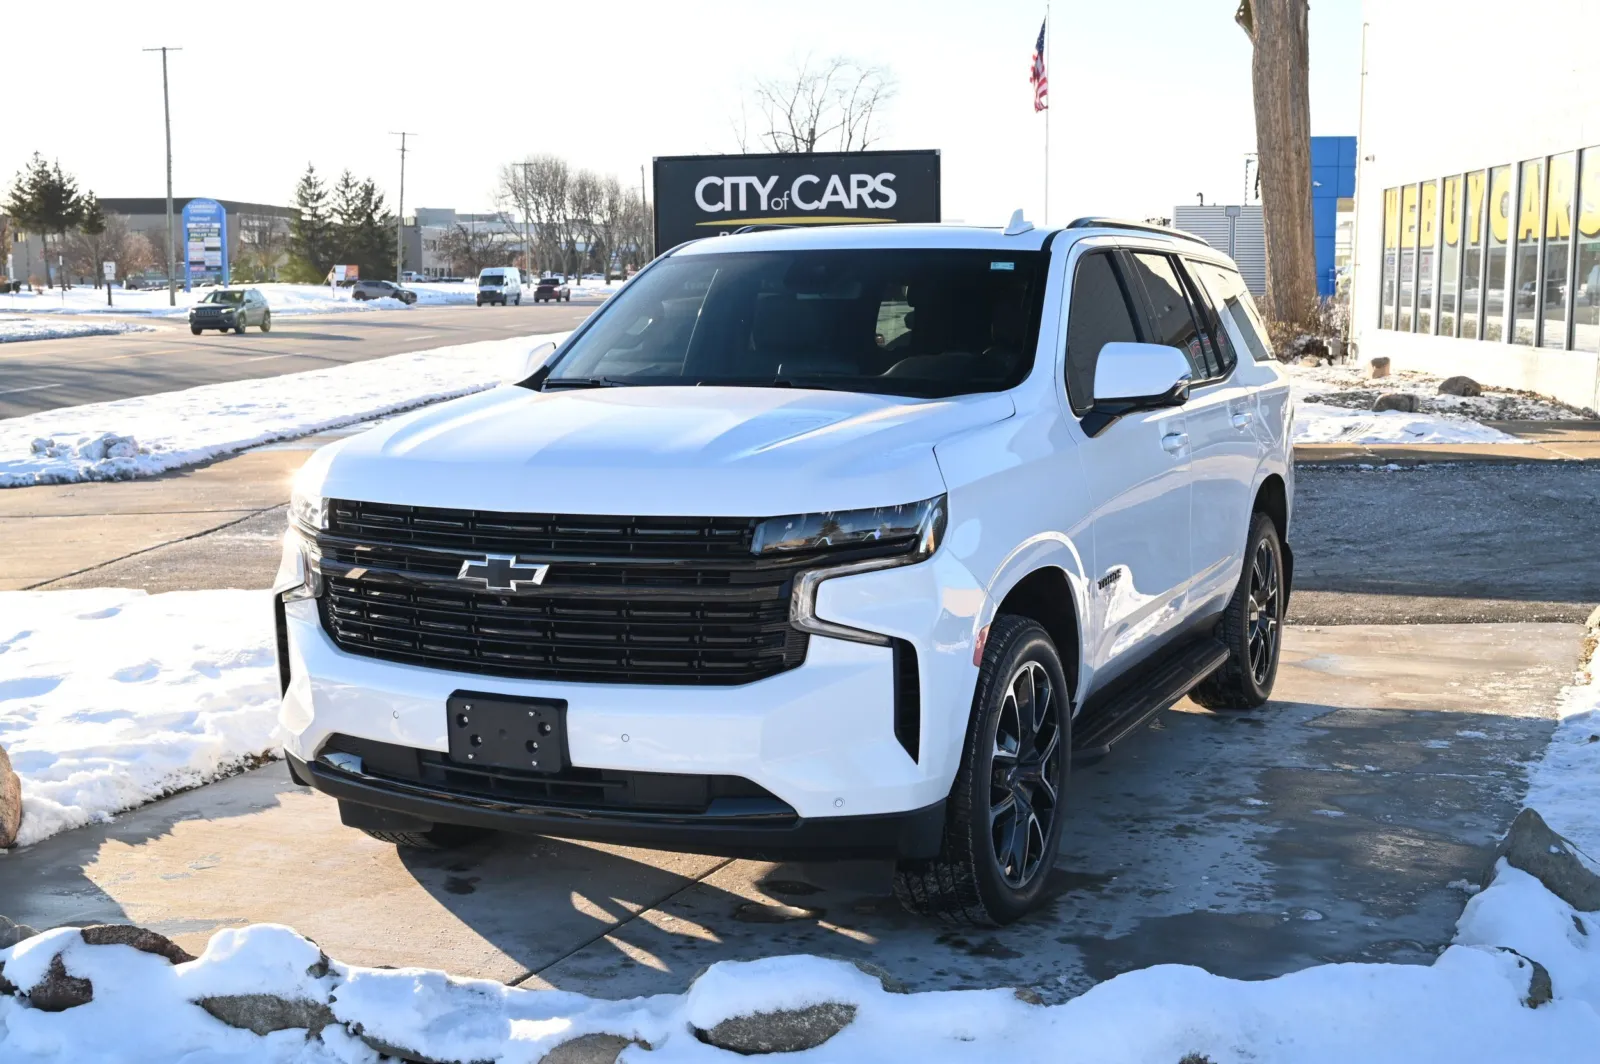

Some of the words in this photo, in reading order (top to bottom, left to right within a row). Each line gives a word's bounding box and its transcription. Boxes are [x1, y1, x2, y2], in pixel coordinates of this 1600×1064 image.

[694, 175, 779, 213] CITY
[771, 190, 790, 211] of
[790, 172, 898, 211] CARS
[1385, 186, 1418, 249] WE
[1420, 173, 1486, 249] BUY
[1489, 150, 1600, 243] CARS
